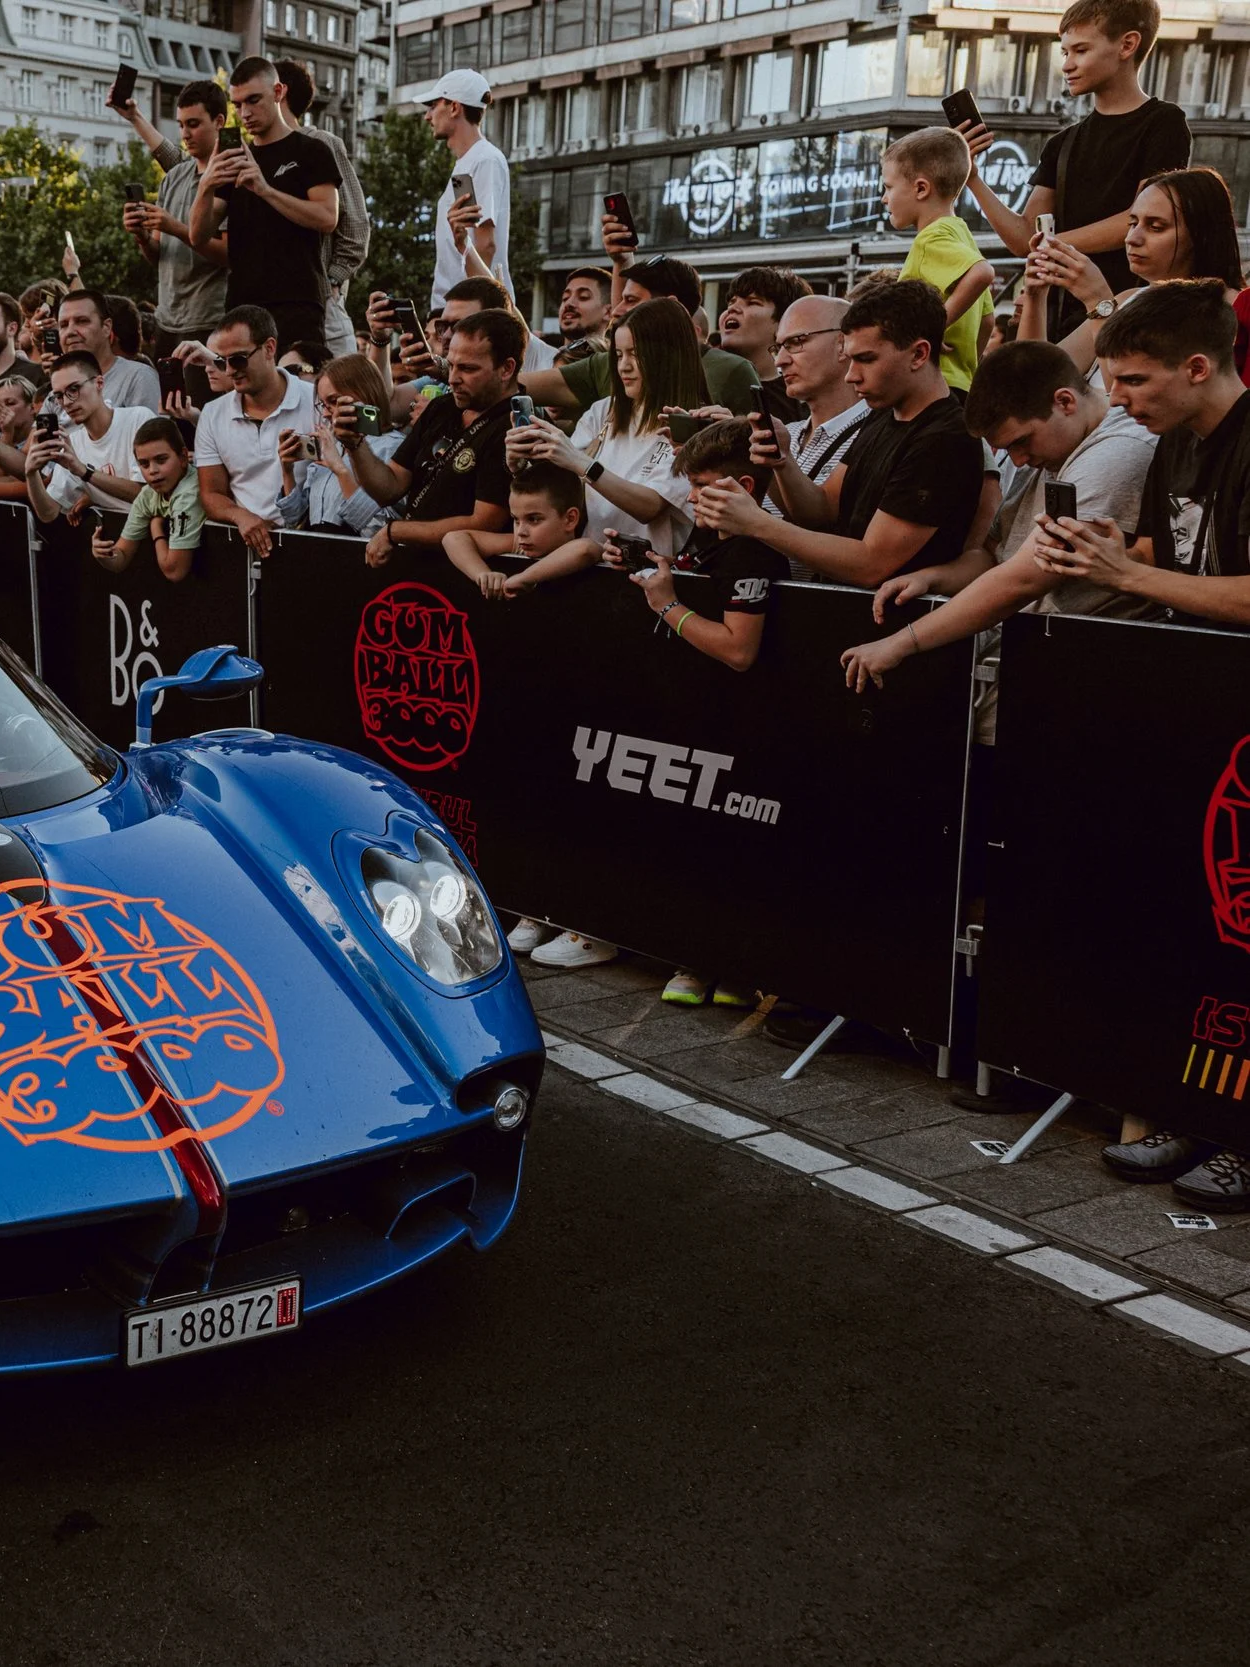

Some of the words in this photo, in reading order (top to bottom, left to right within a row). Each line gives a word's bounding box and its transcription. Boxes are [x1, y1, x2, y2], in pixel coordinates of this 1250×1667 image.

[759, 174, 818, 197] COMING
[731, 577, 770, 602] SDC
[362, 596, 470, 658] GUM
[359, 649, 472, 706] BALL
[363, 695, 471, 757] 3000
[572, 725, 781, 825] YEET.com
[1192, 995, 1250, 1047] IS
